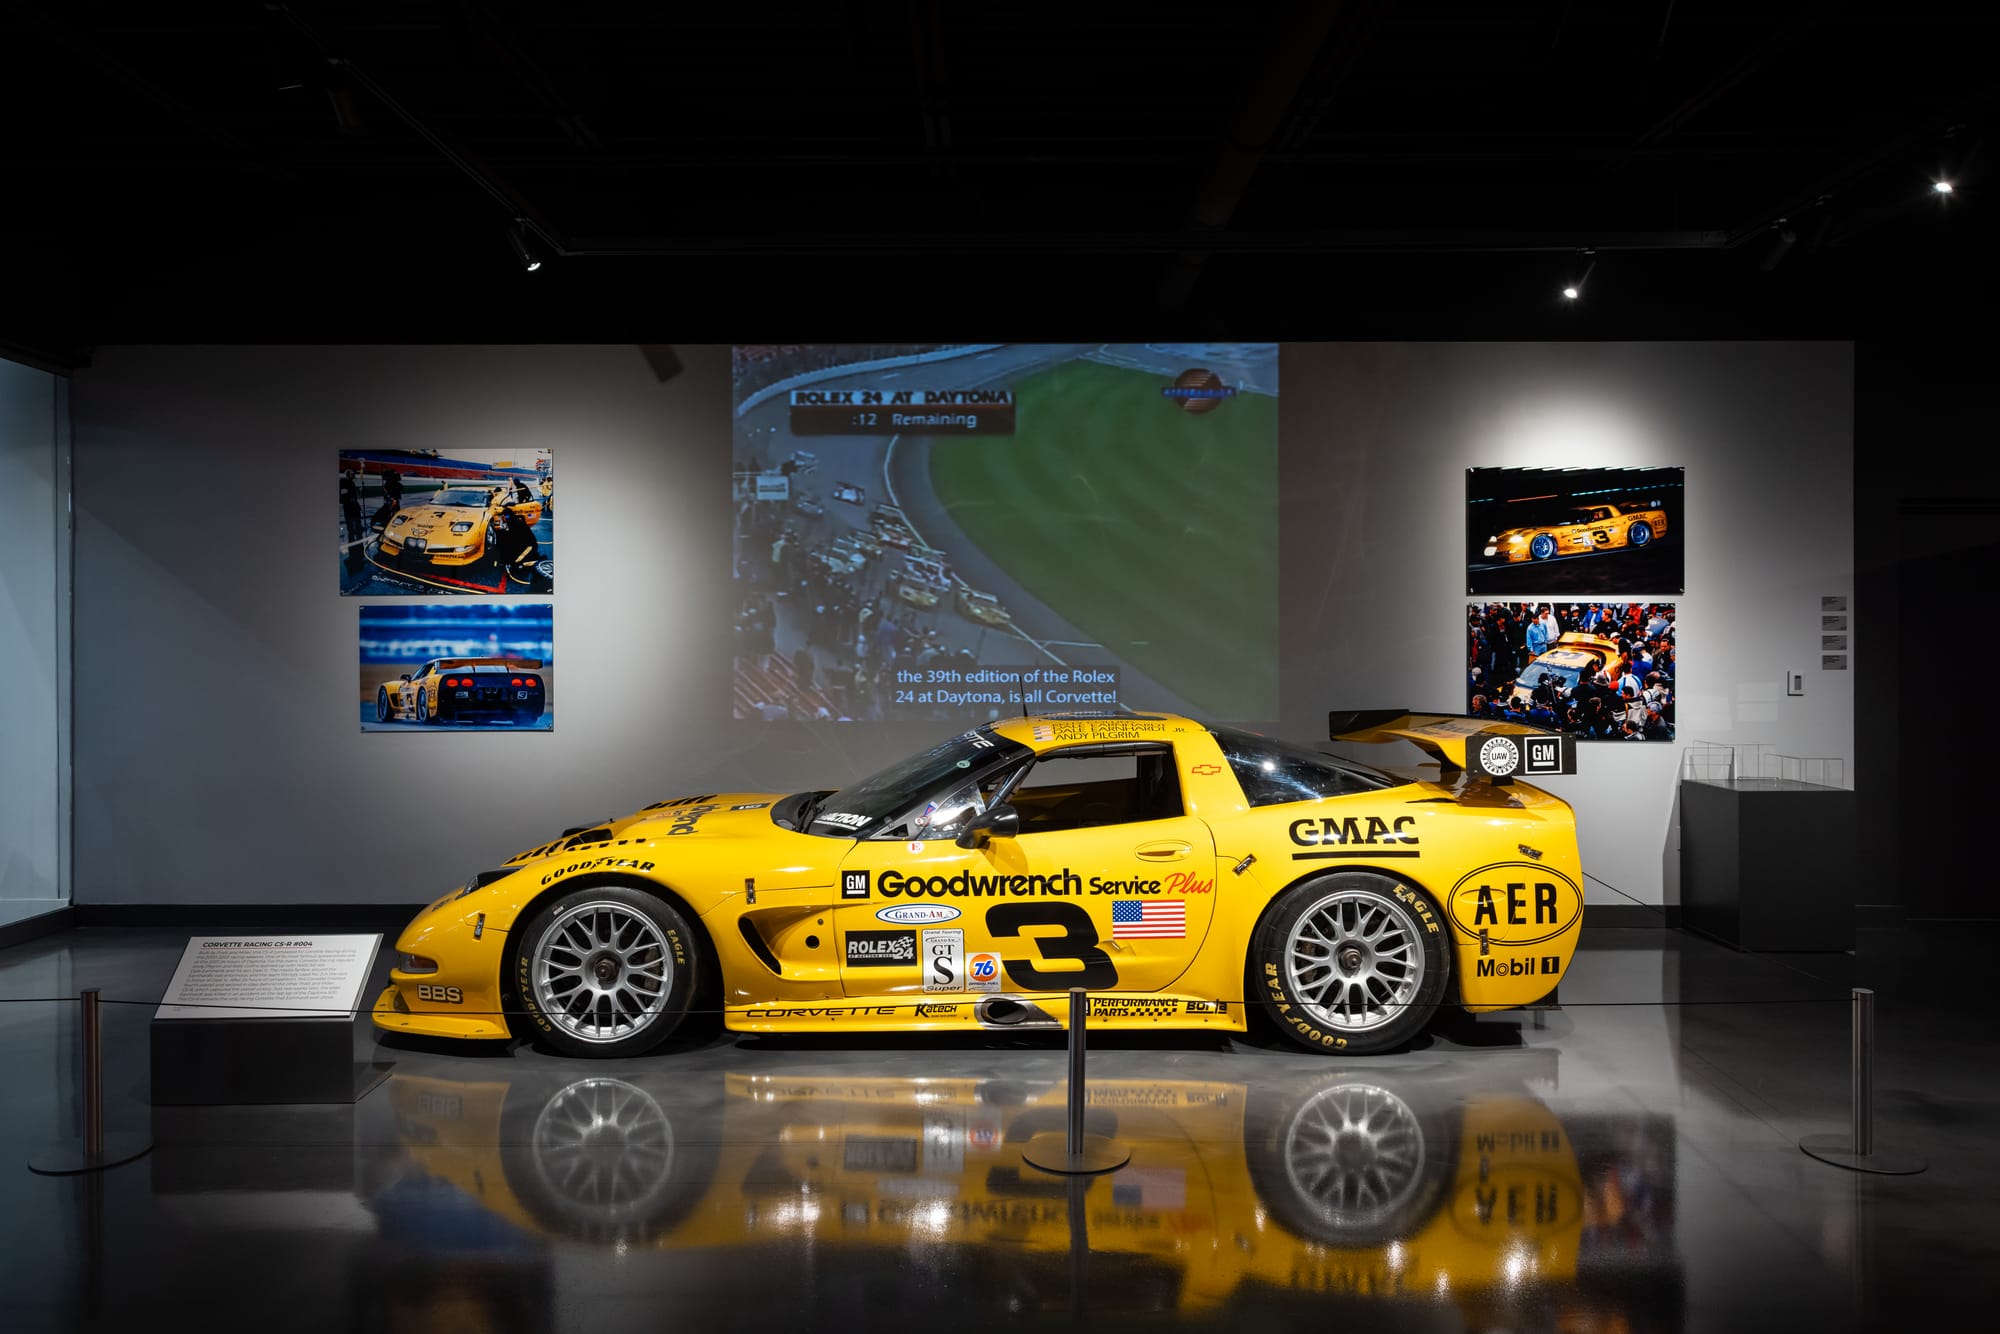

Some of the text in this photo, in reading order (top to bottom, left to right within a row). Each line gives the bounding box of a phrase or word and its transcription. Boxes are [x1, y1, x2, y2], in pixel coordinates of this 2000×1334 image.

[796, 391, 1008, 404] ROLEX 24 AT DAYTONA
[892, 413, 977, 427] Remaining
[1592, 530, 1610, 544] 3
[897, 669, 1115, 683] the 39th edition of the Rolex
[895, 689, 1117, 706] 24 at Daytona, is all Corvette!
[1093, 731, 1140, 739] PILGRIM
[1491, 752, 1508, 760] UAW
[1532, 744, 1555, 761] GM
[1288, 816, 1420, 847] GMAC
[540, 856, 656, 886] GOODYEAR
[846, 875, 866, 890] GM
[877, 868, 1214, 898] Goodwrench Service Plus
[1392, 882, 1440, 934] EAGLE
[1474, 882, 1557, 925] AER
[667, 929, 686, 965] EAGLE
[848, 940, 897, 954] ROLEX
[893, 947, 914, 959] 24
[932, 944, 955, 955] GT
[985, 901, 1118, 991] 3
[933, 956, 954, 985] S
[974, 960, 994, 976] 76
[1477, 958, 1535, 977] Mobil
[418, 984, 464, 1004] BBS
[746, 1007, 896, 1018] CORVETTE
[1093, 1008, 1129, 1016] PARTS
[1263, 961, 1349, 1050] GOODYEAR
